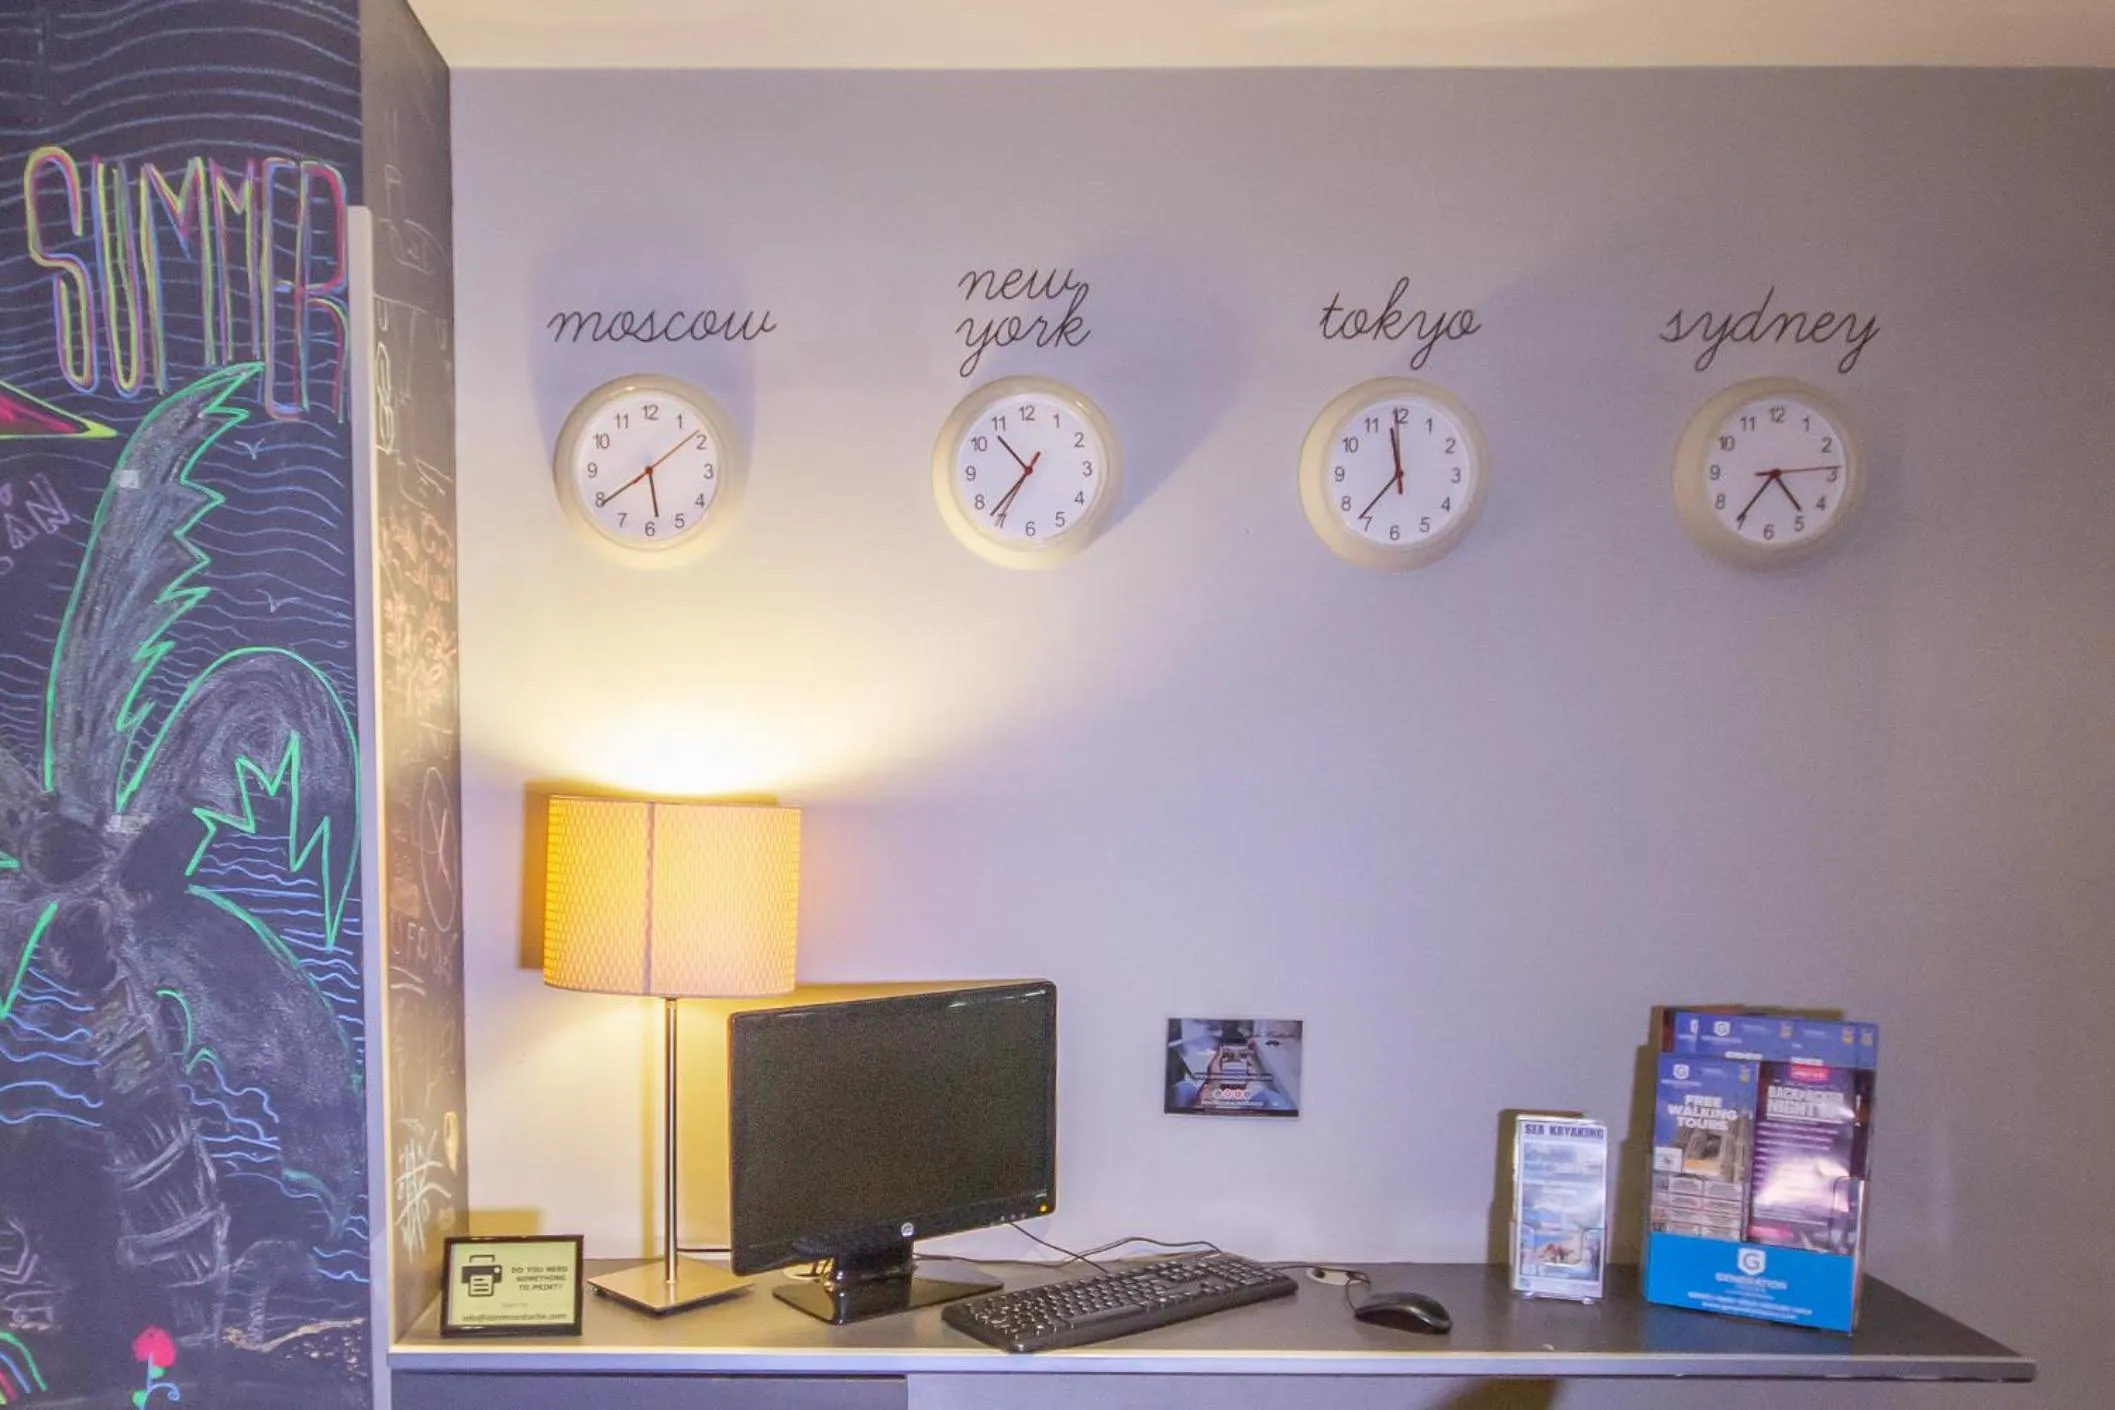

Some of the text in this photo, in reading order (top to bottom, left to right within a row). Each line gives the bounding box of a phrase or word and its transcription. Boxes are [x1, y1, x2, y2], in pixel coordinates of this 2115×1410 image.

[958, 264, 1081, 301] new
[546, 307, 777, 344] moscow
[956, 280, 1092, 378] york
[1319, 275, 1481, 371] tokyo
[1660, 286, 1880, 374] sydney
[641, 404, 659, 420] 12
[1018, 405, 1035, 422] 12
[1392, 407, 1409, 424] 12
[1768, 405, 1786, 423] 12
[614, 414, 629, 429] 11
[676, 414, 682, 429] 1
[991, 416, 1006, 431] 11
[1053, 414, 1060, 429] 1
[1365, 417, 1379, 433] 11
[1426, 417, 1433, 434] 1
[1740, 416, 1756, 432] 11
[1802, 416, 1810, 432] 1
[593, 433, 610, 449] 10
[695, 434, 707, 450] 2
[971, 436, 988, 452] 10
[1074, 431, 1085, 448] 2
[1342, 436, 1359, 453] 10
[1445, 437, 1456, 454] 2
[1718, 435, 1735, 451] 10
[1821, 436, 1832, 453] 2
[587, 462, 598, 478] 9
[703, 463, 714, 479] 3
[965, 465, 976, 481] 9
[1082, 461, 1092, 477] 3
[1334, 466, 1345, 482] 9
[1451, 467, 1461, 483] 3
[1709, 464, 1721, 480] 9
[1827, 468, 1838, 482] 3
[595, 491, 606, 508] 8
[695, 493, 705, 508] 4
[974, 494, 985, 510] 8
[1074, 490, 1085, 505] 4
[1341, 495, 1351, 512] 8
[1441, 497, 1451, 512] 4
[1715, 493, 1726, 510] 8
[1816, 495, 1826, 510] 4
[618, 512, 628, 528] 7
[674, 513, 685, 529] 5
[1055, 511, 1065, 527] 5
[1362, 515, 1373, 532] 7
[1419, 516, 1430, 532] 5
[1794, 516, 1805, 532] 5
[645, 521, 655, 537] 6
[1025, 521, 1036, 537] 6
[1389, 524, 1400, 541] 6
[1763, 523, 1774, 540] 6
[1668, 1103, 1739, 1121] WALKING
[1677, 1115, 1729, 1131] TOURS
[1525, 1123, 1604, 1140] SEA KAYAKING
